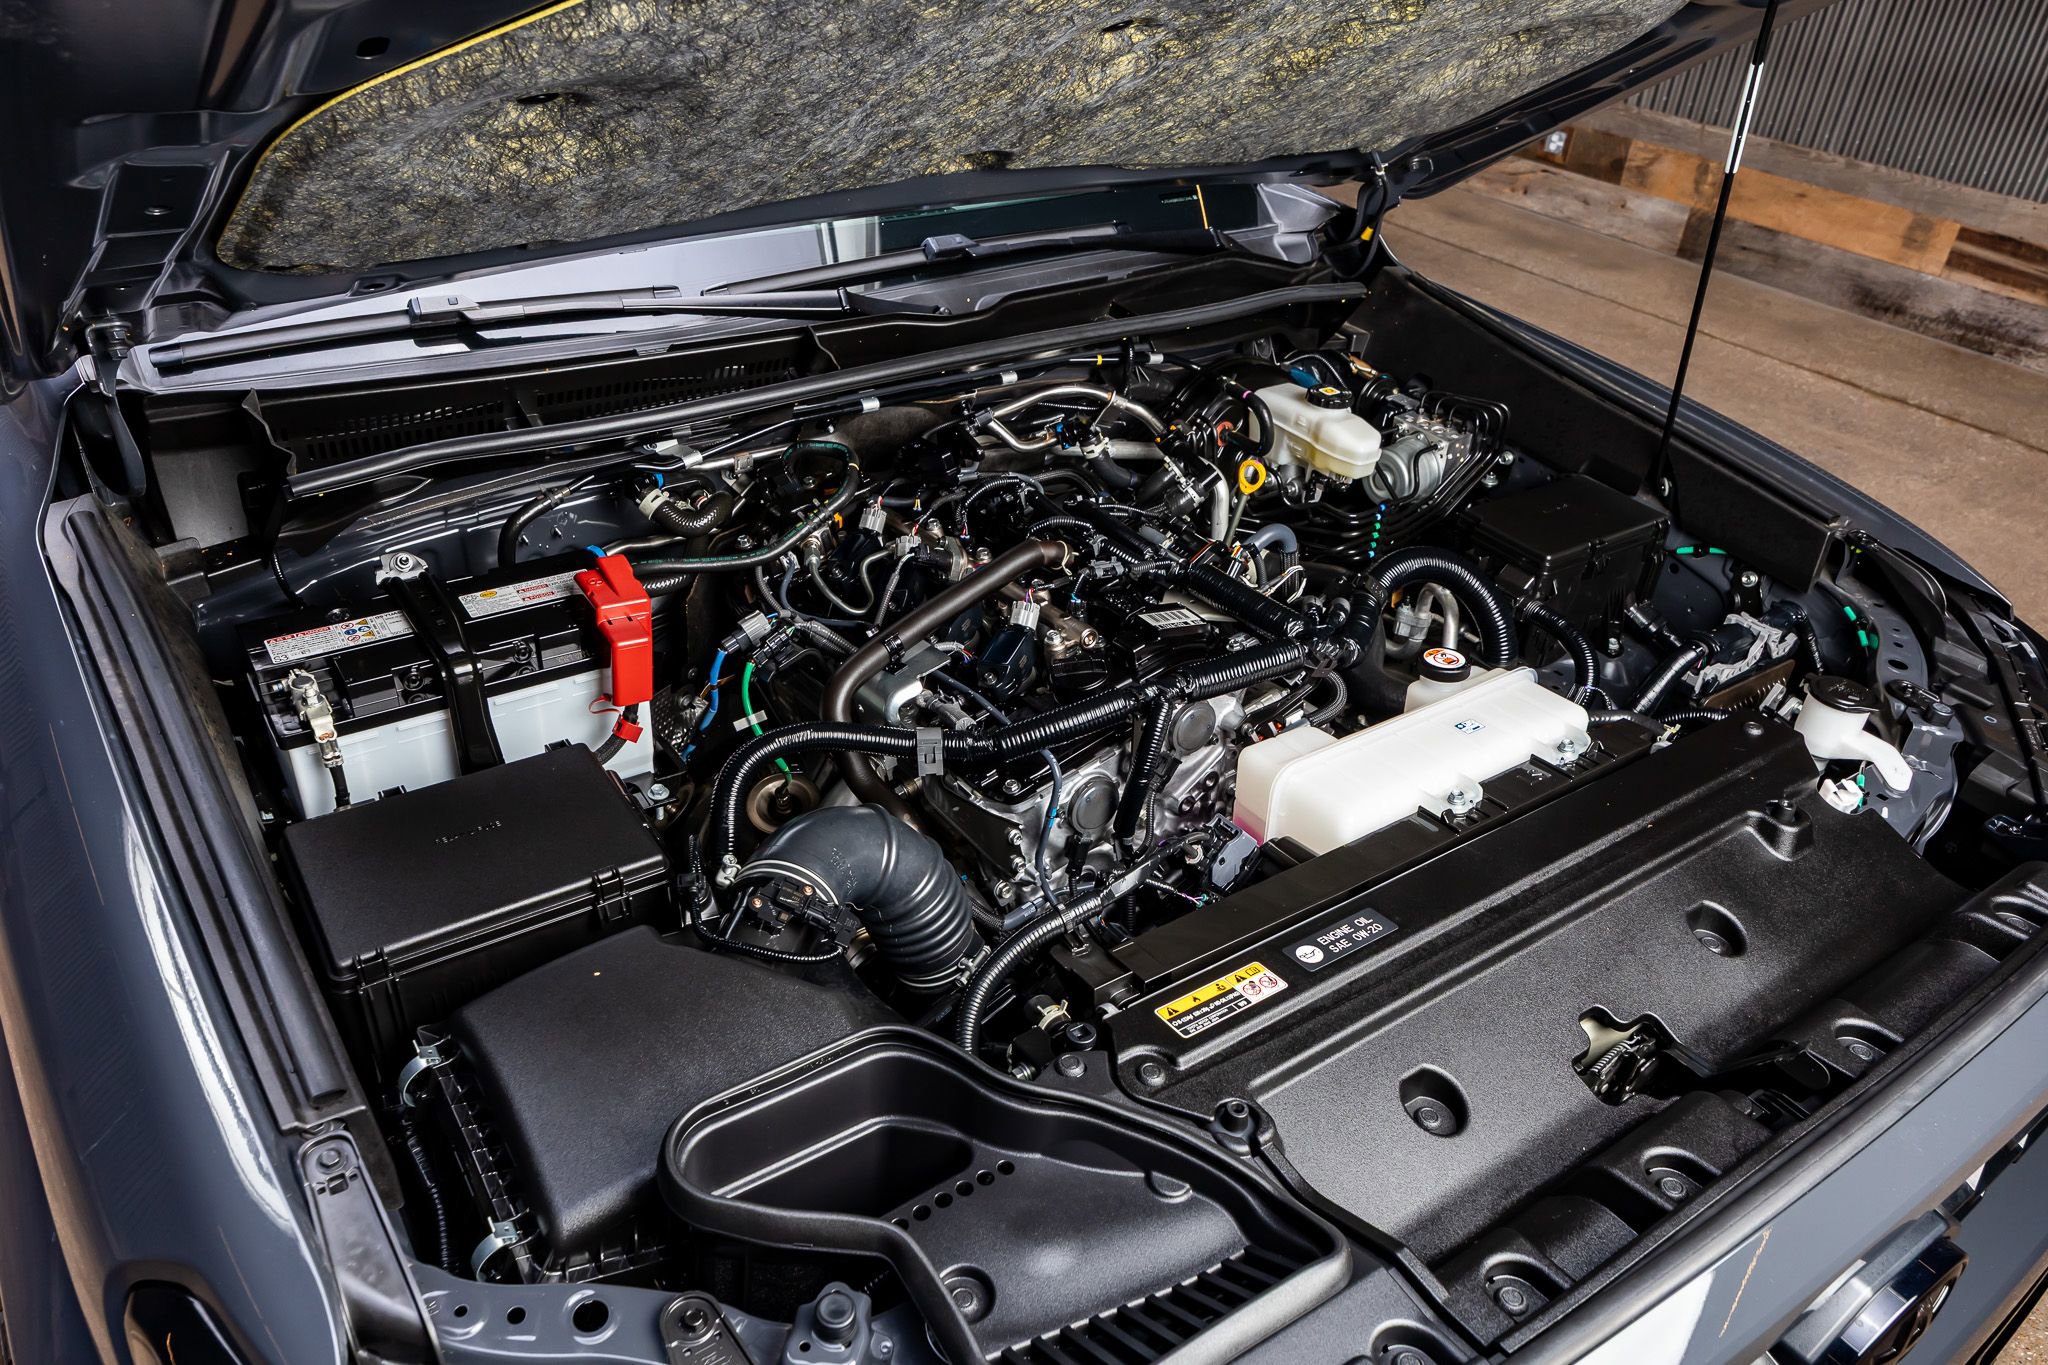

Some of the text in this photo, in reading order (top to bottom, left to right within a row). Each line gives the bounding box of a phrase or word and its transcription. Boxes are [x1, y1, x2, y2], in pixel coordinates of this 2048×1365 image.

[1316, 916, 1374, 946] ENGINE OIL
[1329, 922, 1383, 953] SAE 0W-20
